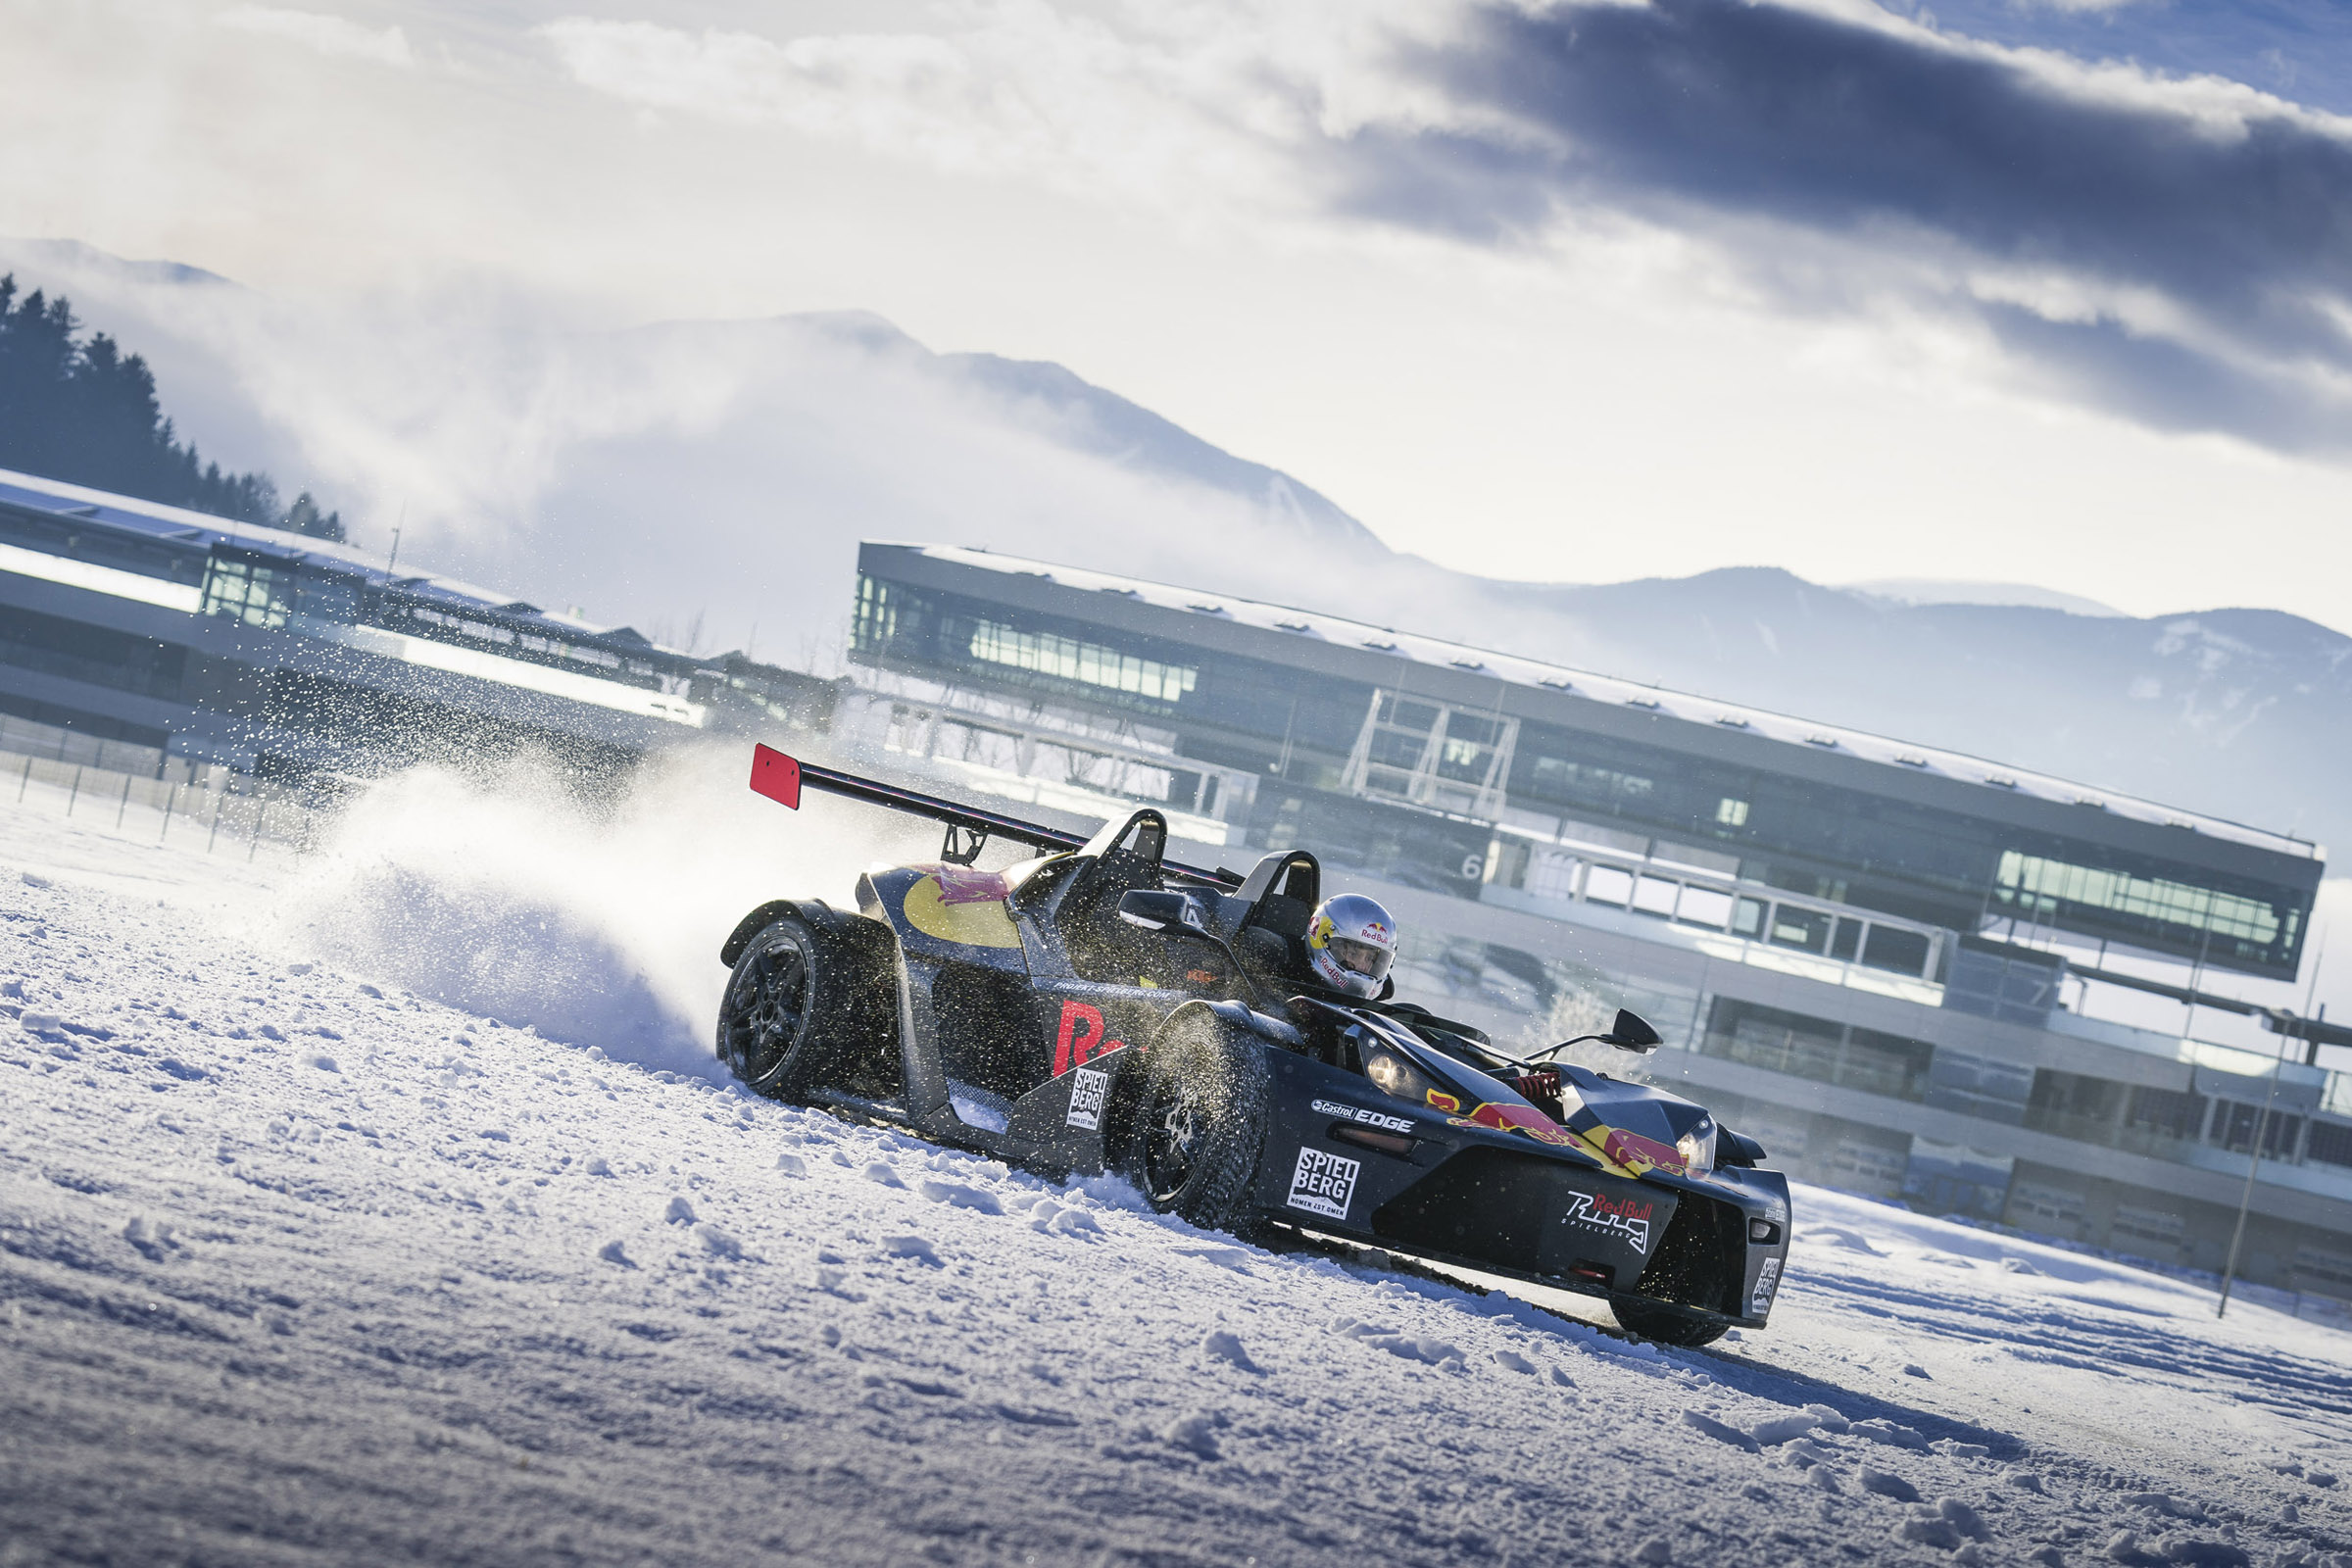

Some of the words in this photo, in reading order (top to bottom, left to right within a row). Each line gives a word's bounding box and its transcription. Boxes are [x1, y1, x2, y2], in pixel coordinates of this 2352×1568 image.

[1462, 855, 1482, 879] 6
[1361, 929, 1376, 940] Red
[1320, 957, 1334, 974] Red
[1332, 972, 1348, 989] Bull
[1076, 1072, 1106, 1094] SPIEL
[1071, 1089, 1101, 1111] BERG
[1321, 1102, 1354, 1117] Castrol
[1354, 1109, 1415, 1133] EDGE
[1300, 1152, 1352, 1182] SPIEL
[1293, 1169, 1347, 1200] BERG
[1290, 1197, 1312, 1207] NOMEN
[1327, 1206, 1345, 1216] OMEN
[1592, 1194, 1626, 1215] Red
[1625, 1200, 1653, 1220] Bull
[1560, 1218, 1631, 1239] SPIELBERG
